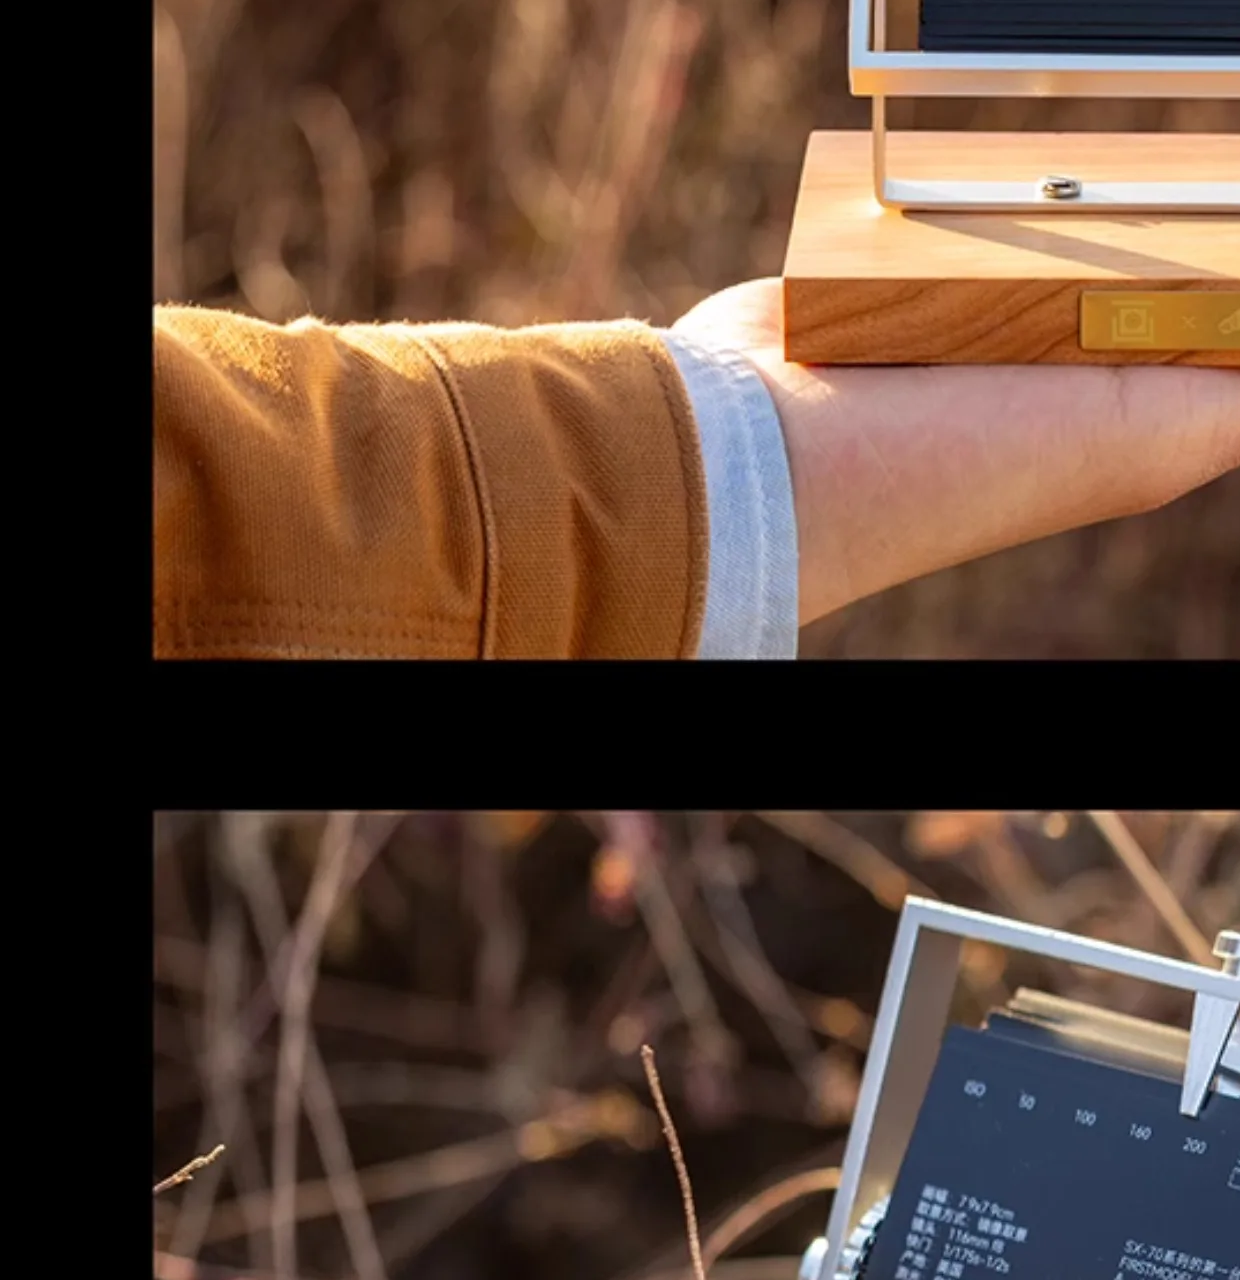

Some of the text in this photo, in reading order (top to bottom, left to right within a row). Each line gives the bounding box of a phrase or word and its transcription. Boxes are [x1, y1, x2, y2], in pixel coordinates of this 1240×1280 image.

[1018, 1094, 1035, 1110] 50
[1075, 1109, 1097, 1126] 100
[1129, 1123, 1151, 1140] 160
[1182, 1137, 1207, 1154] 200
